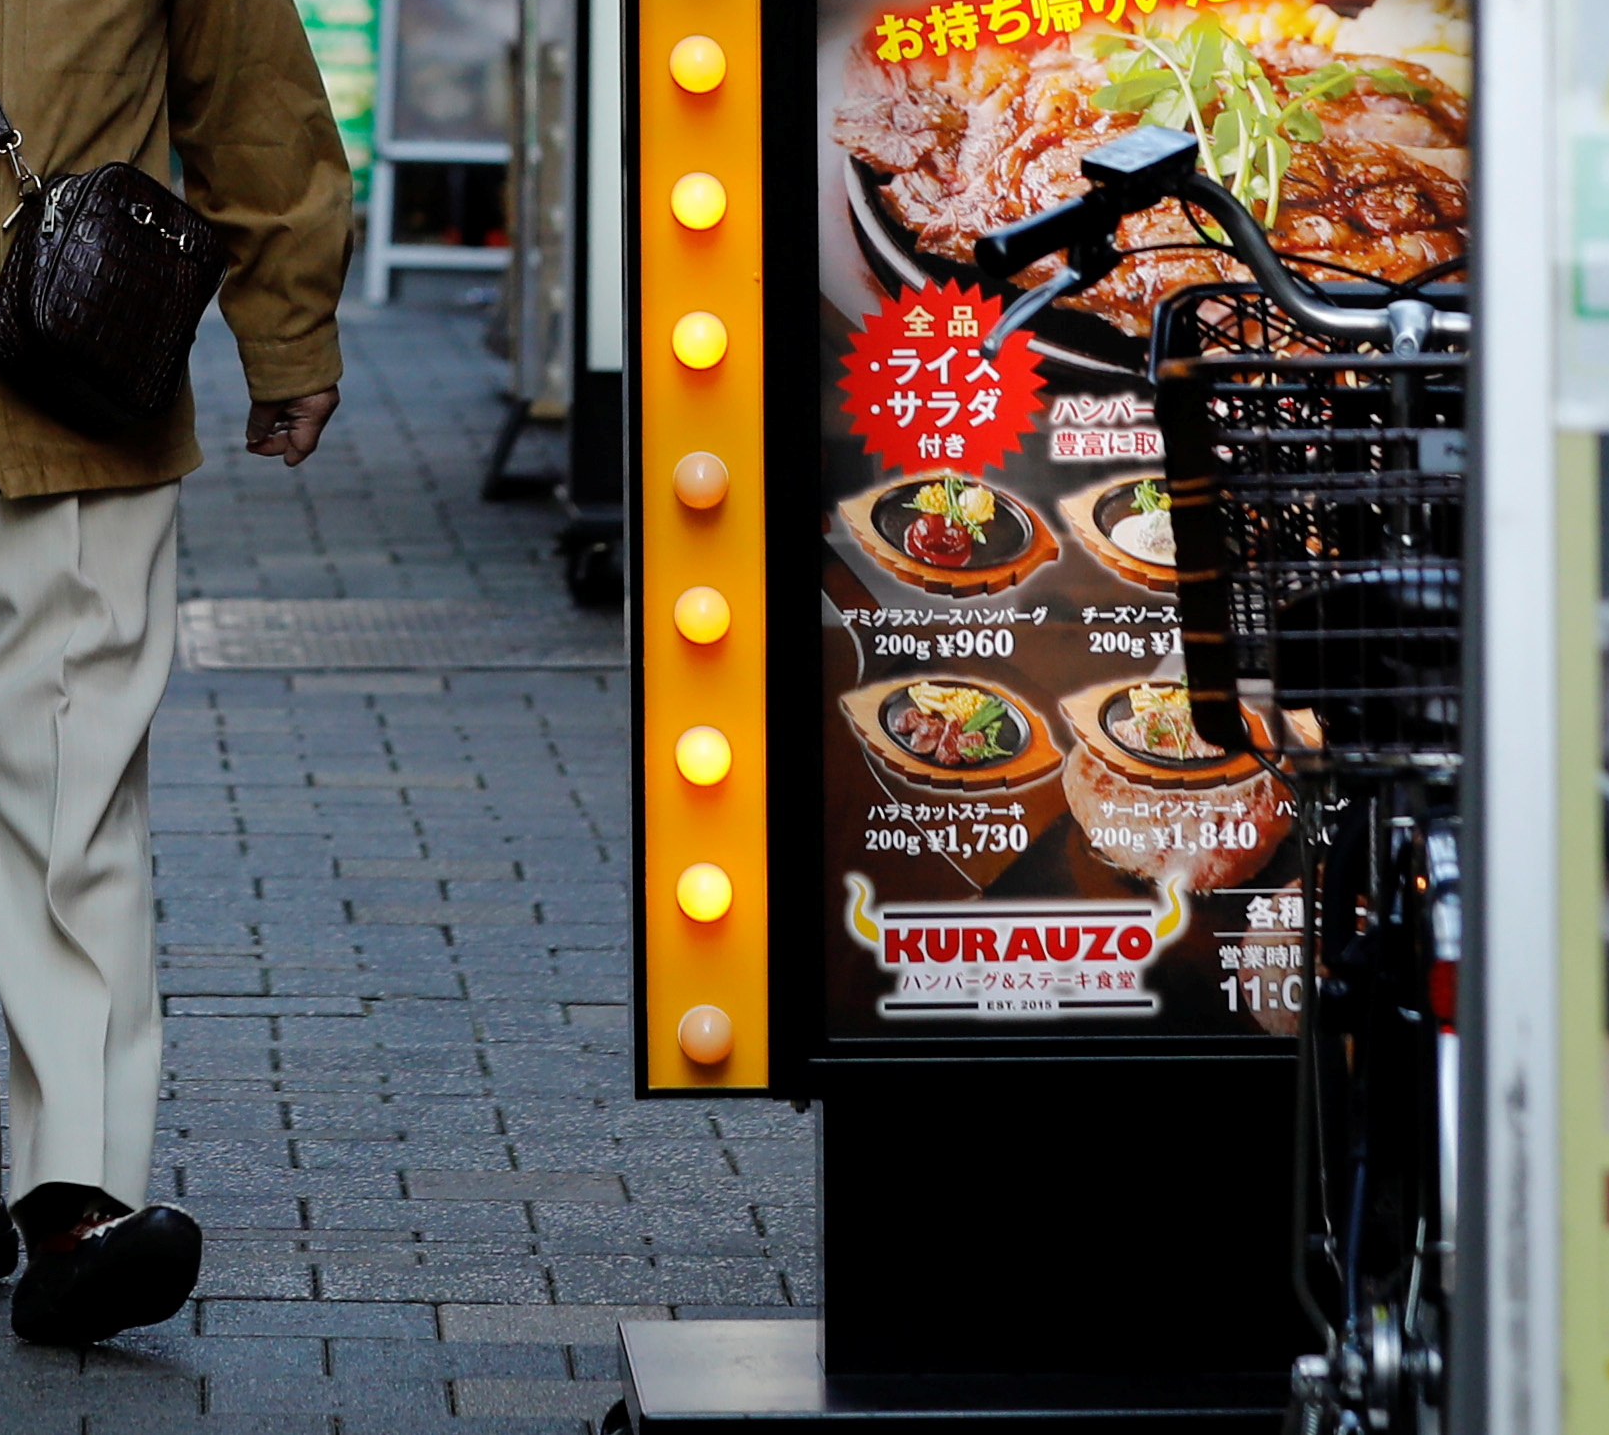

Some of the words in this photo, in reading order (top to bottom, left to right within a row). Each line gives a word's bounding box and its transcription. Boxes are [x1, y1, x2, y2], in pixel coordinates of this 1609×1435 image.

[903, 305, 979, 338] 全品
[917, 433, 966, 459] 付き
[841, 605, 1048, 627] デミグラスソースハンバーグ
[874, 633, 931, 660] 200g
[936, 629, 1015, 659] ¥960
[1089, 632, 1145, 659] 200g
[868, 802, 1025, 821] ハラミカットステーキ
[1100, 800, 1248, 820] サーロインステーキ
[865, 826, 920, 855] 200g
[927, 823, 1028, 855] ¥1,730
[1091, 826, 1146, 854] 200g
[1151, 822, 1256, 853] ¥1,840
[884, 926, 1153, 965] KURAUZO
[902, 969, 1137, 993] ハンバーグ&ステーキ食堂
[987, 999, 1016, 1012] EST.
[1021, 999, 1053, 1011] 2015
